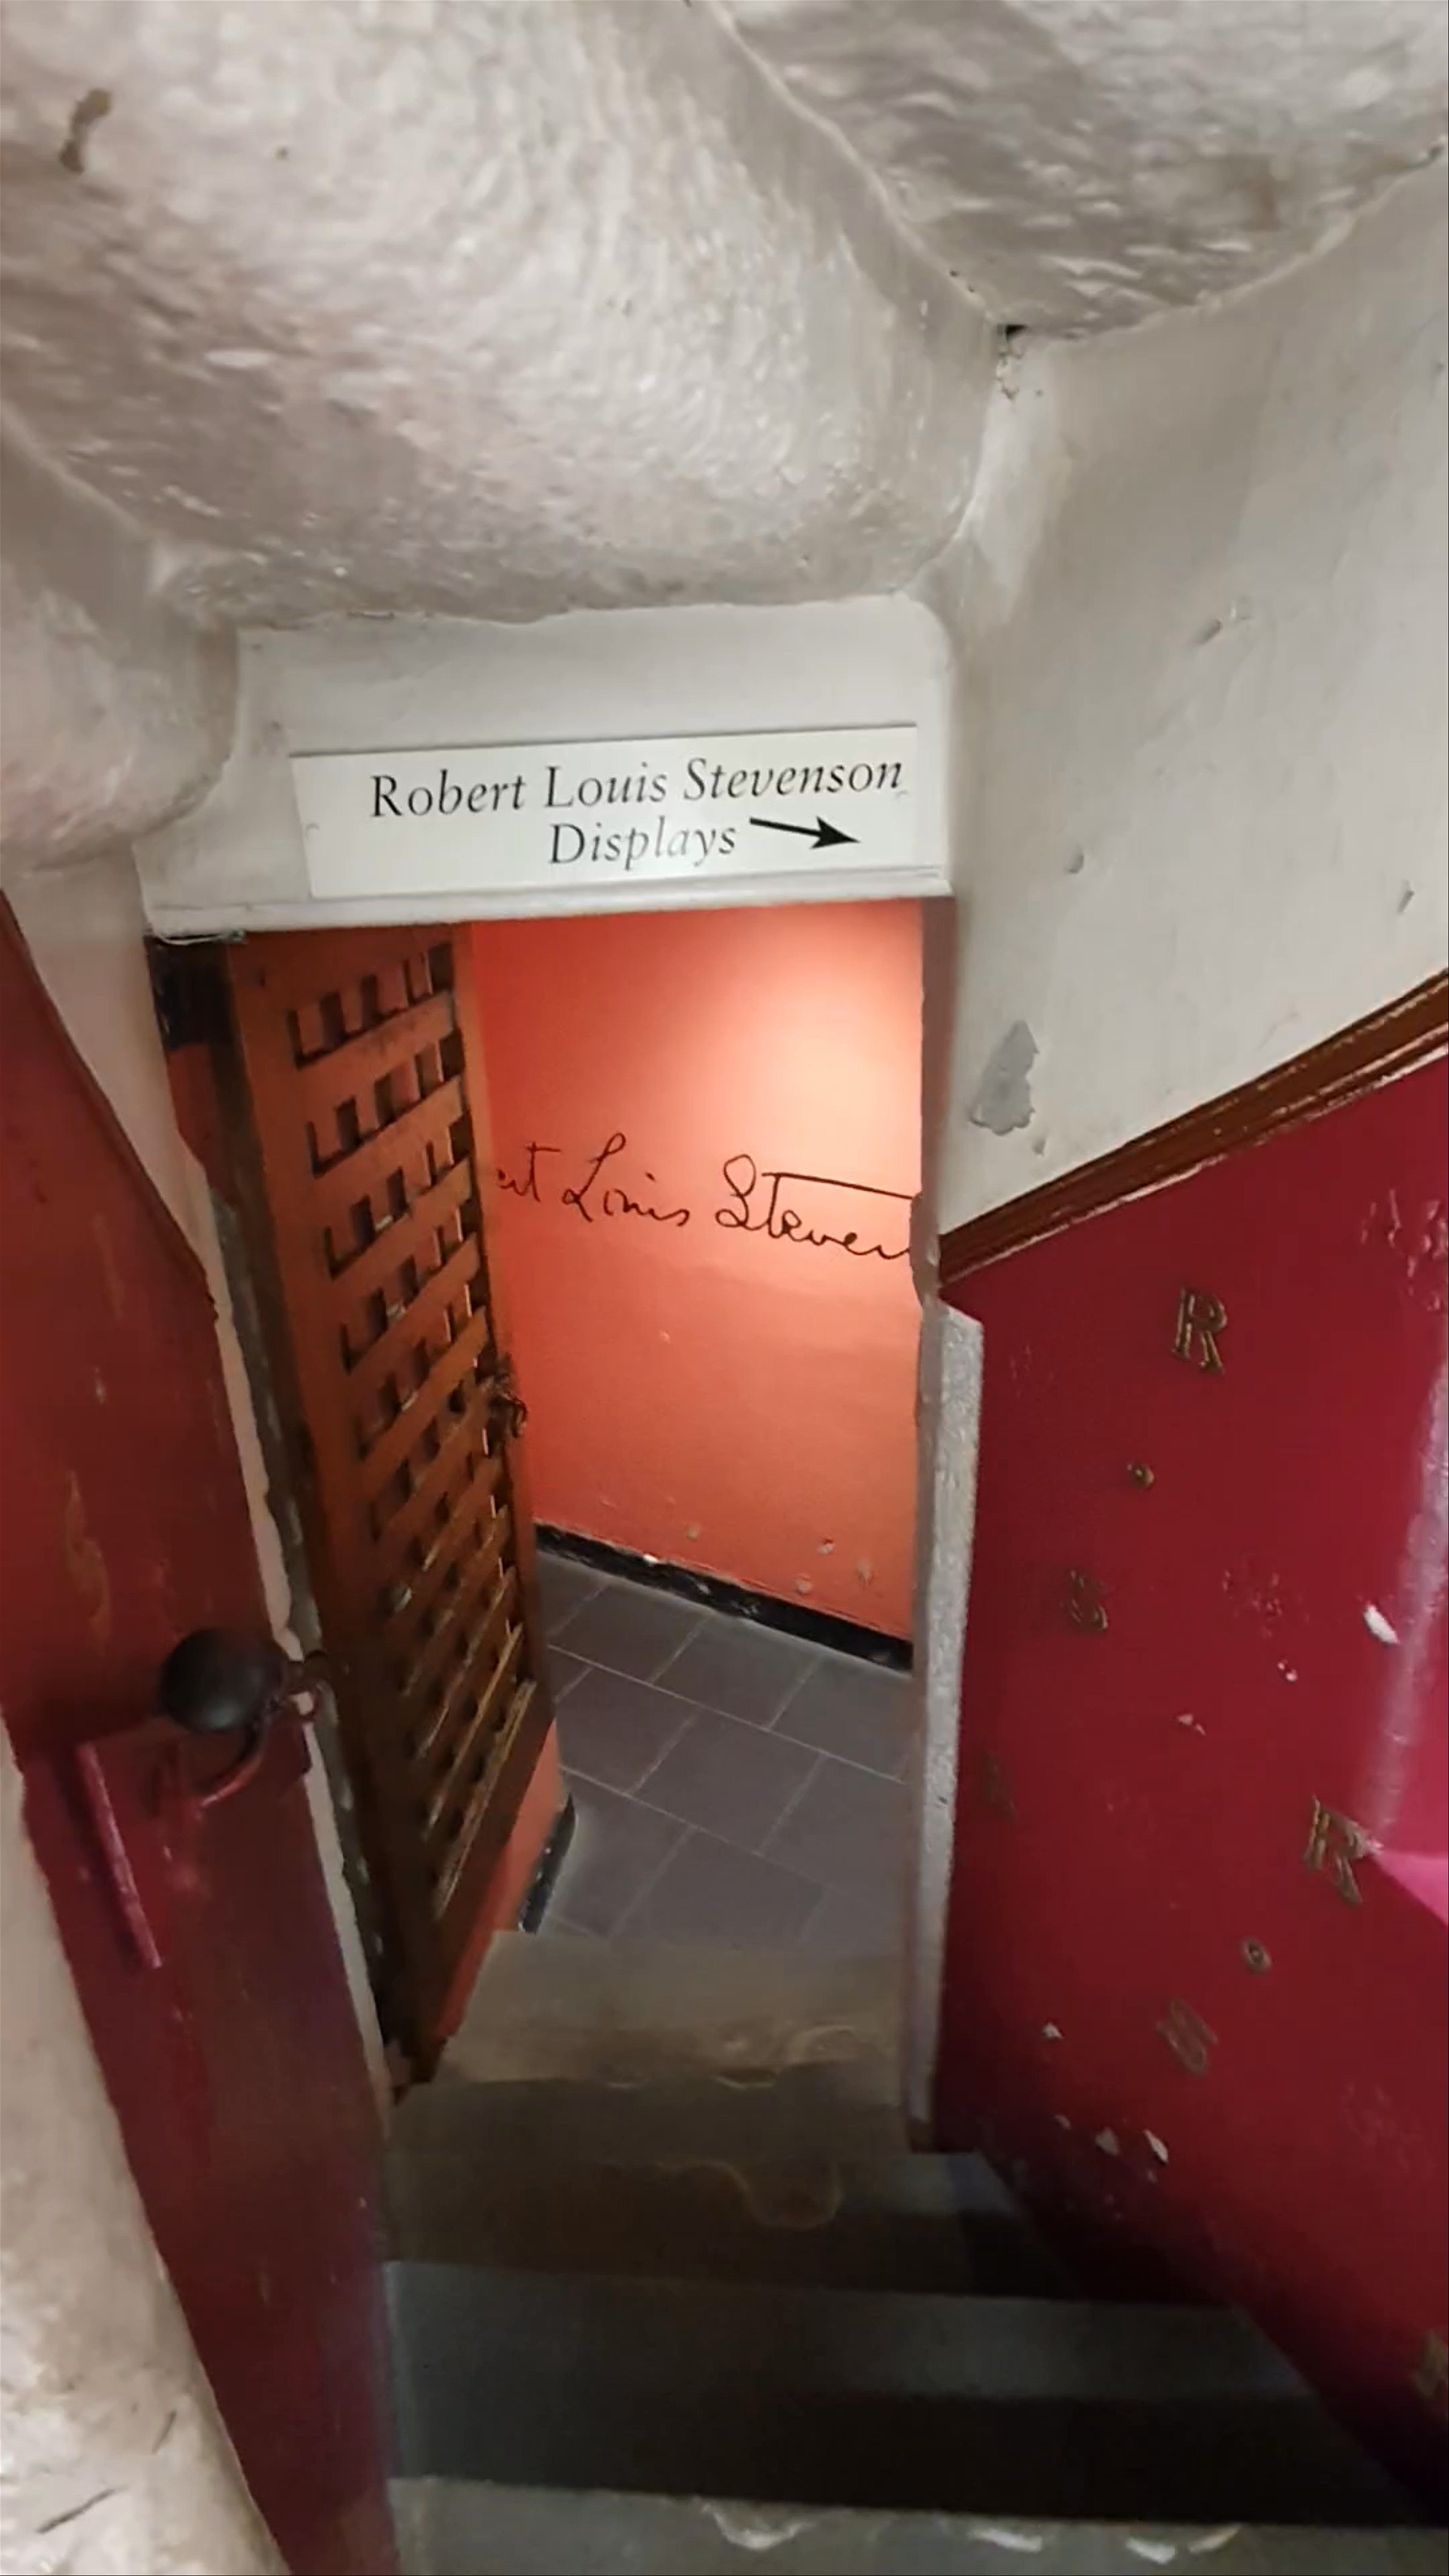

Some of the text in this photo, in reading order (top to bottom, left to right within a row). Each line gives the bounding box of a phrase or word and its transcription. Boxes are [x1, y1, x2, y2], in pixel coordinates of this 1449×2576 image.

[370, 757, 902, 818] Robert Louis Stevenson
[549, 815, 736, 871] Displays
[561, 1132, 690, 1227] Louis
